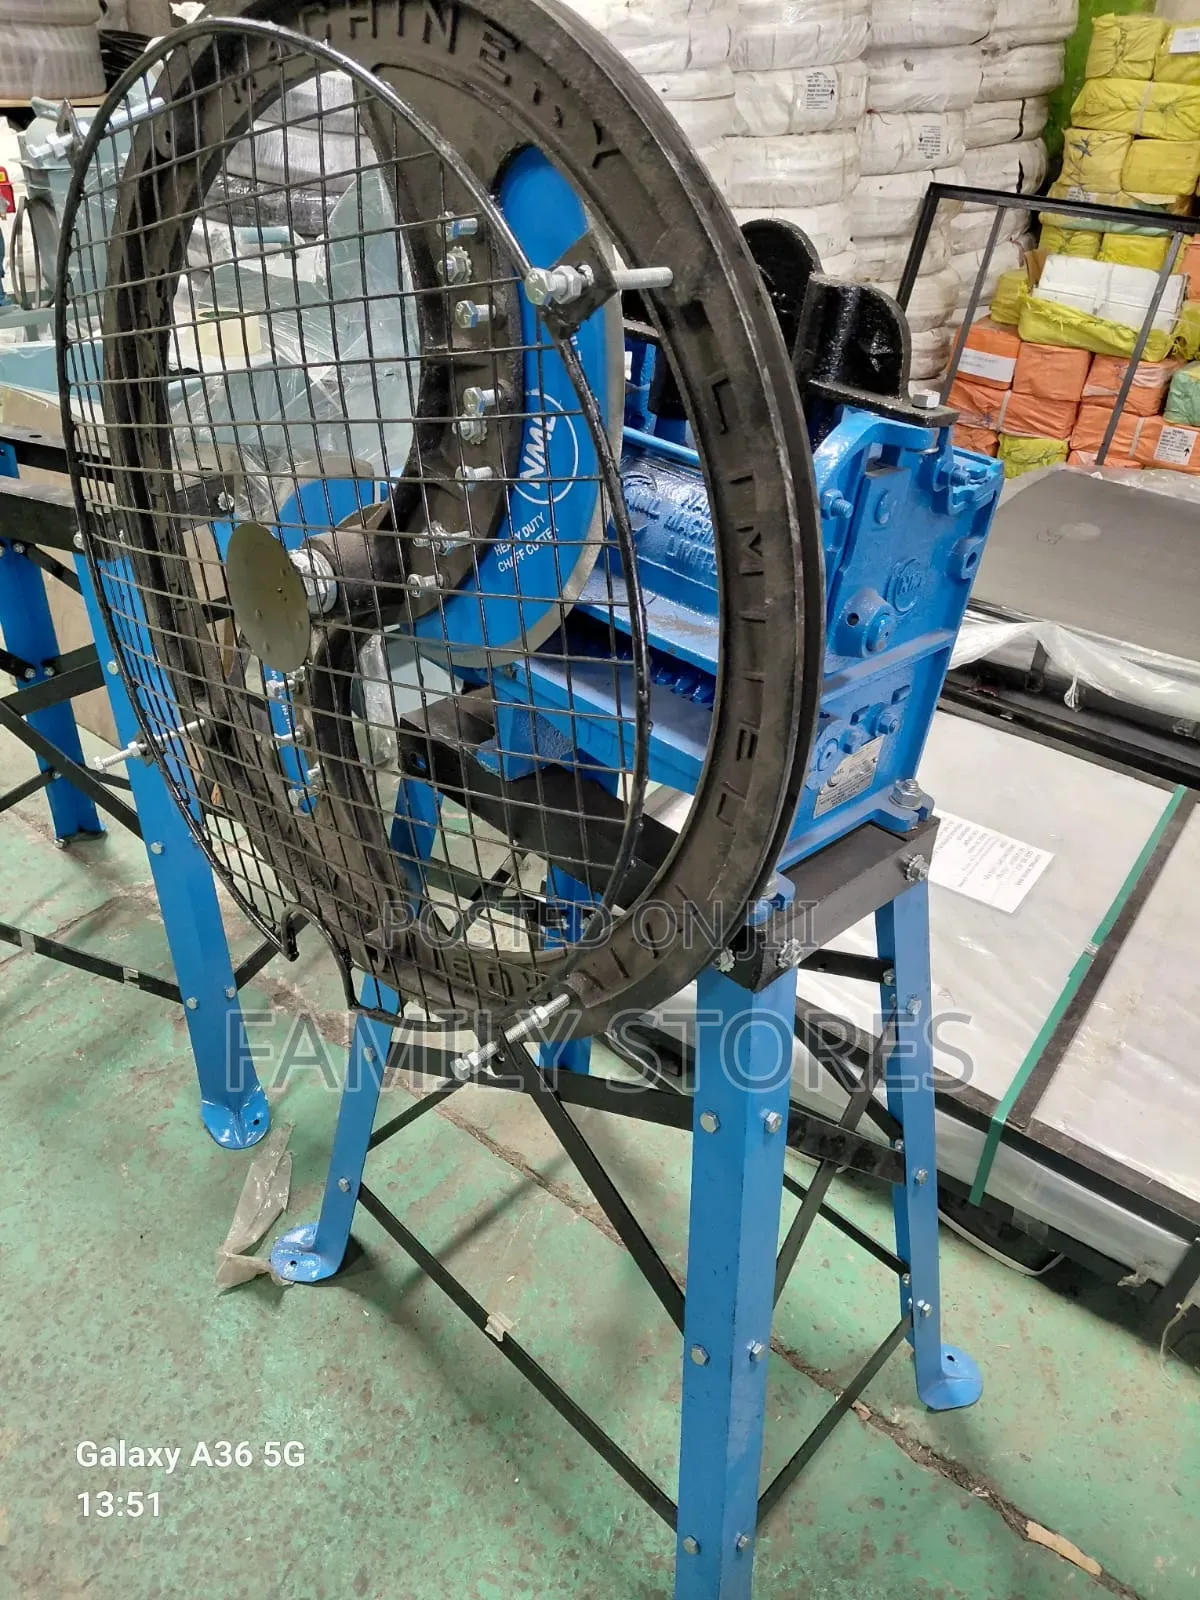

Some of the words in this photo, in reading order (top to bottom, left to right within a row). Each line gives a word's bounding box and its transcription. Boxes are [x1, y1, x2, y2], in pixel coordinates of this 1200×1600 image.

[493, 530, 522, 557] HEAY
[521, 511, 545, 538] DUTY
[525, 527, 560, 556] CUTE
